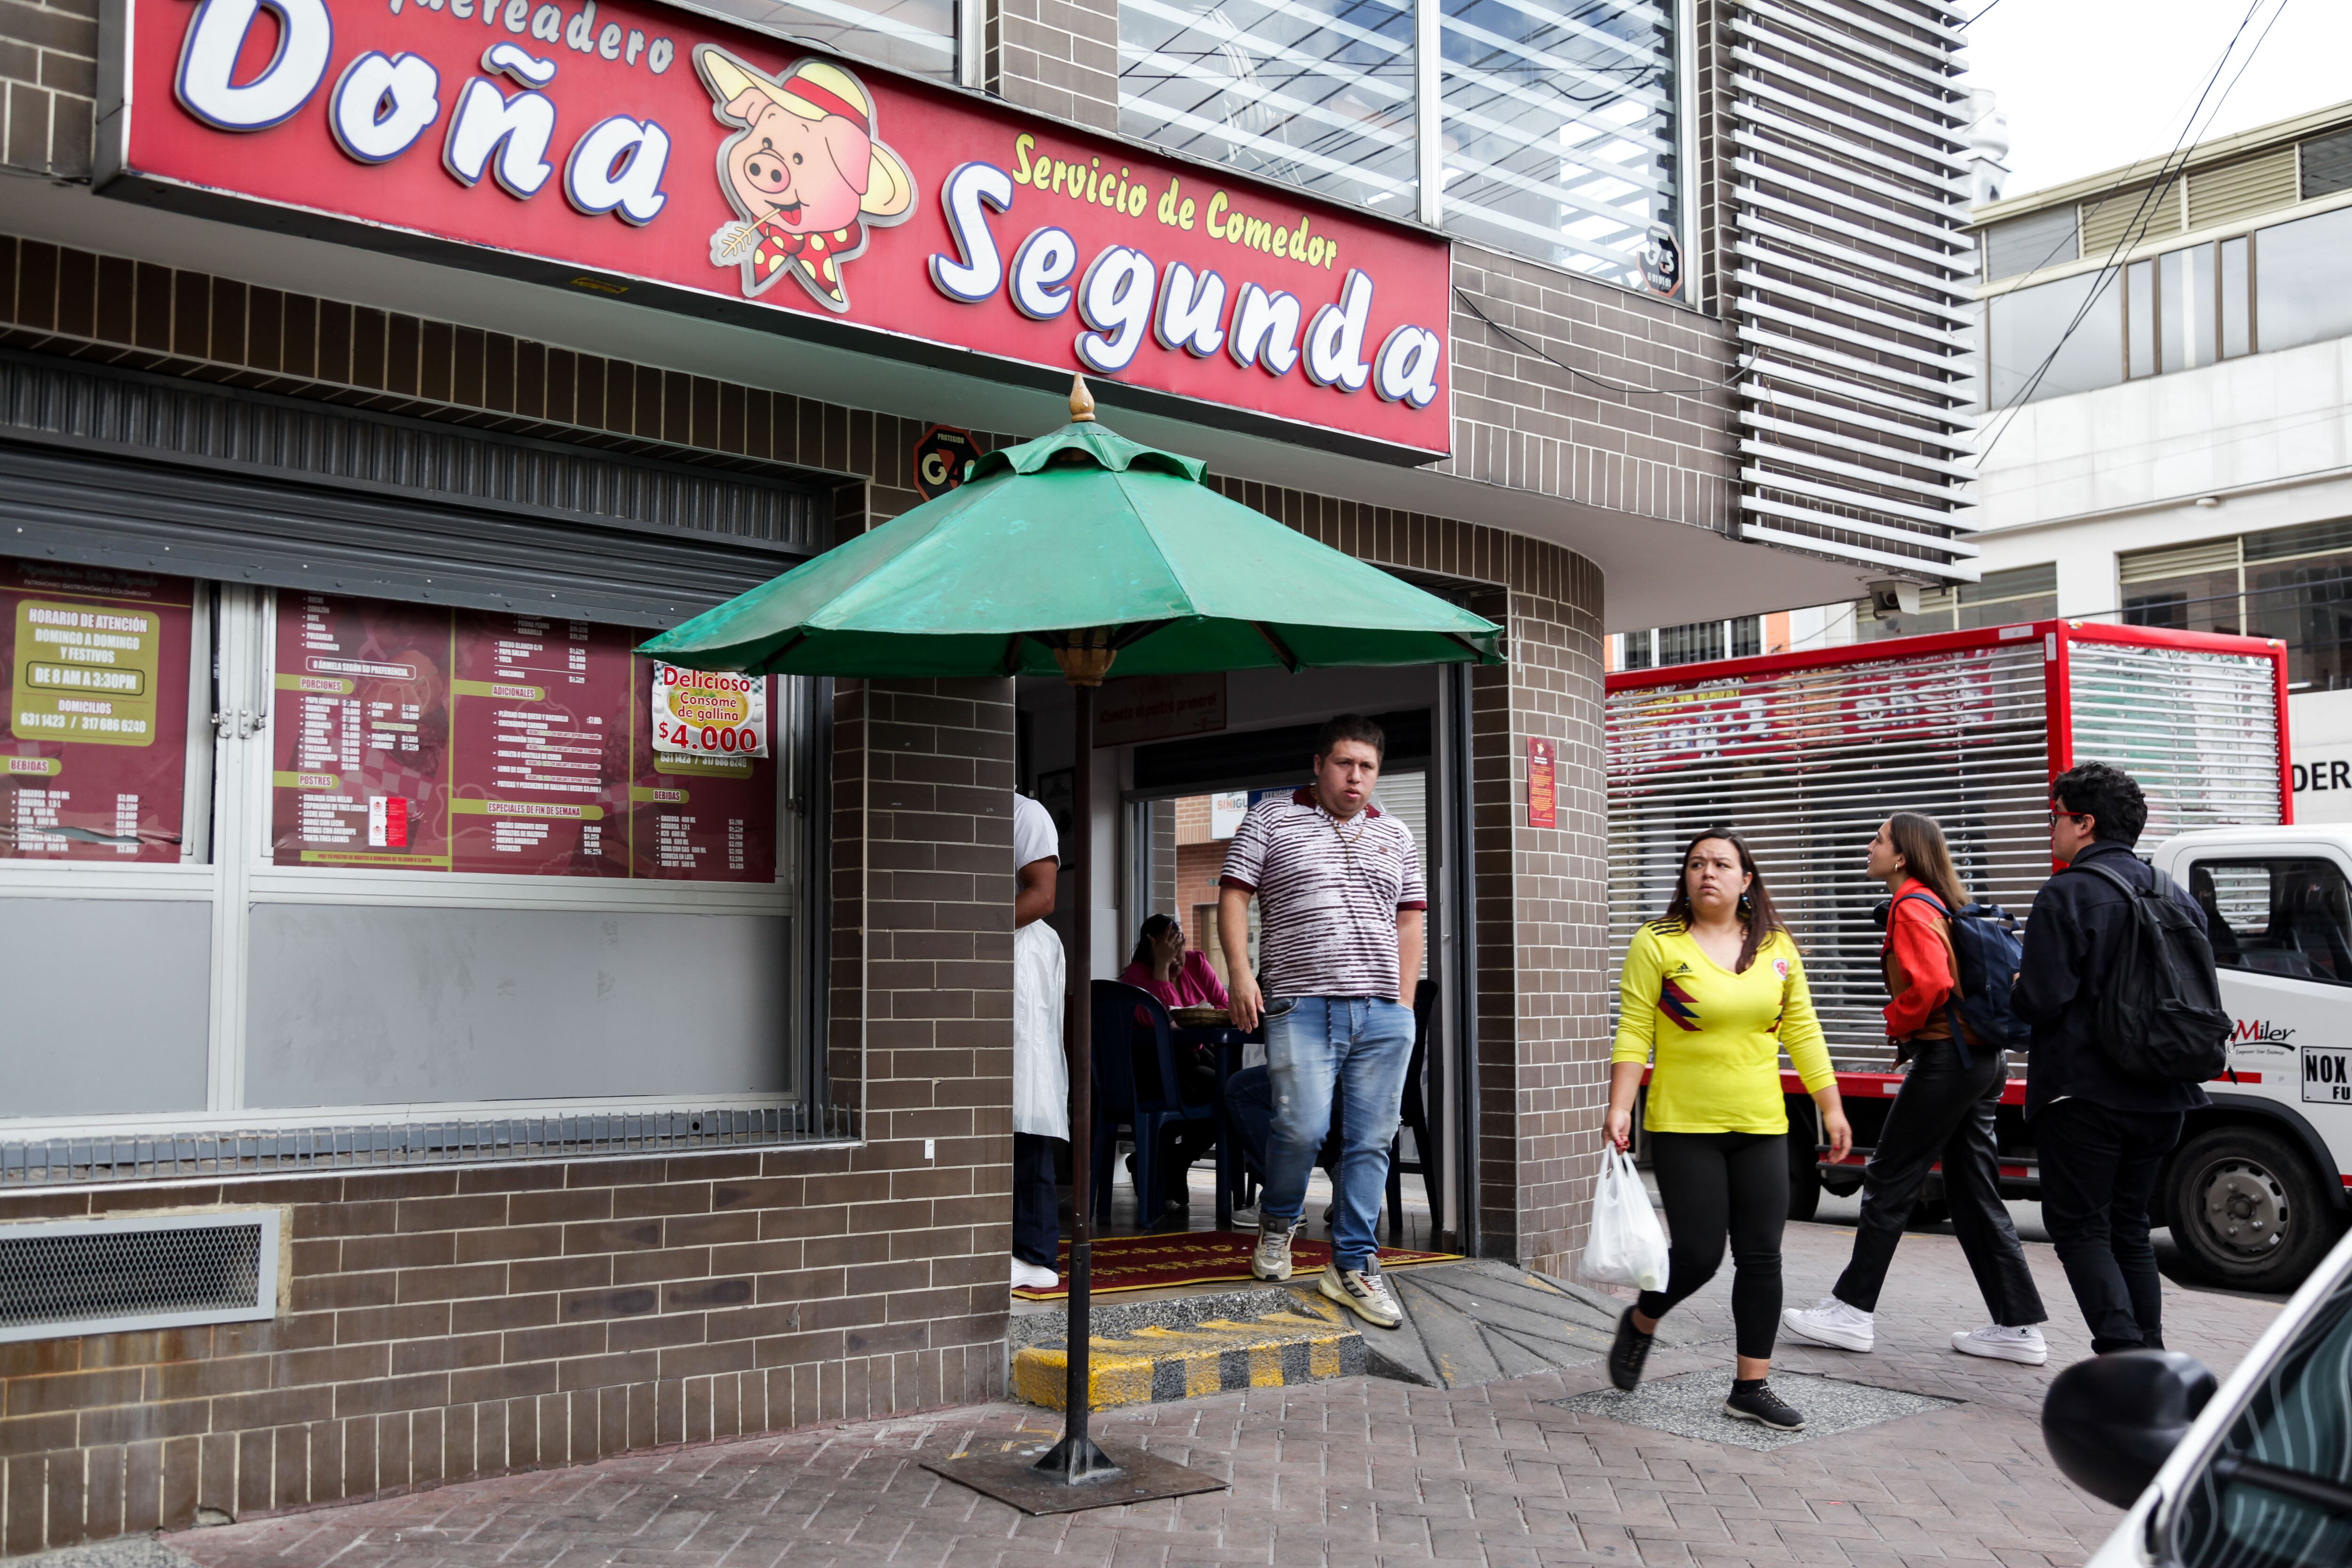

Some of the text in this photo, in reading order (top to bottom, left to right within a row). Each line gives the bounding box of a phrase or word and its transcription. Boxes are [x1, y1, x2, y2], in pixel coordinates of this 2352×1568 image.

[175, 0, 672, 226] Doña
[1012, 132, 1338, 270] Servicio de Comedor
[928, 160, 1440, 409] Segunda
[938, 433, 964, 444] PROTEGIDO
[29, 608, 147, 632] HORARIO DE ATENCIÓN
[35, 629, 139, 650] DOMINGO A DOMINGO
[61, 646, 114, 663] Y FESTIVOS
[318, 660, 342, 670] ÁRMELA
[342, 662, 362, 672] SEGÚN
[362, 665, 370, 673] SU
[35, 667, 136, 689] DE 8 AM A 3:30PM
[302, 678, 341, 691] PORCIONES
[664, 667, 750, 692] Delicioso
[494, 686, 534, 698] ADICIONALES
[680, 692, 736, 707] Consomé
[59, 700, 111, 715] DOMICILIOS
[678, 706, 738, 721] de gallina
[21, 712, 40, 725] 631
[42, 714, 65, 728] 1423
[82, 717, 98, 730] 317
[100, 718, 119, 731] 686
[121, 719, 146, 733] 6240
[11, 760, 47, 772] BEBIDAS
[675, 753, 691, 764] 1423
[730, 758, 746, 767] 6240
[300, 775, 331, 786] POSTRES
[19, 789, 46, 798] GASEOSA
[655, 791, 680, 800] BEBIDAS
[489, 803, 524, 813] ESPECIALES
[527, 805, 533, 814] DE
[547, 806, 554, 815] DE
[556, 807, 580, 816] SEMANA
[2305, 1055, 2347, 1083] NOX
